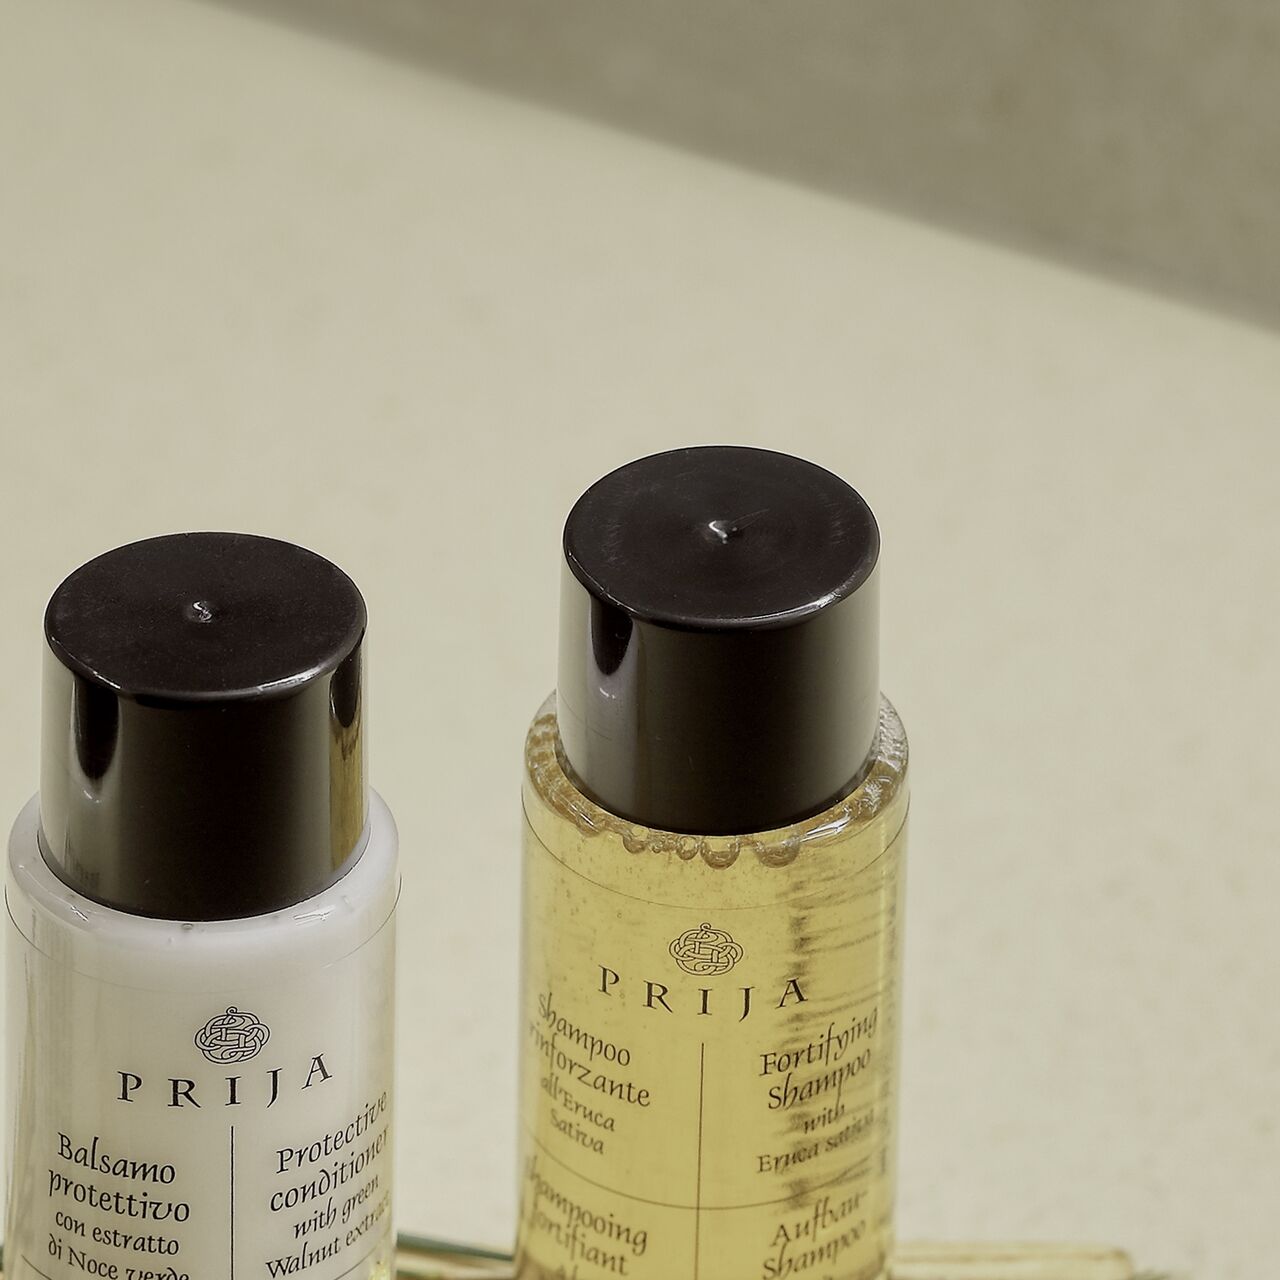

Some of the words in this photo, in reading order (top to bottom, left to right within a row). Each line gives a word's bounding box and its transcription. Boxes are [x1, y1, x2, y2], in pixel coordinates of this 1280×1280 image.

[598, 965, 808, 1022] PRIJA
[758, 1006, 877, 1077] Fortifying
[117, 1053, 333, 1108] PRIJA
[768, 1048, 870, 1111] Shampoo
[58, 1132, 176, 1184] Balsamo
[276, 1091, 387, 1174] Protective
[48, 1169, 190, 1222] protettivo
[270, 1123, 390, 1212] conditioner
[55, 1211, 86, 1237] con
[92, 1227, 179, 1256] estratto
[294, 1196, 337, 1239] with
[342, 1174, 379, 1224] green
[48, 1233, 62, 1260] di
[68, 1246, 119, 1280] Noce
[265, 1241, 341, 1279] Walnut
